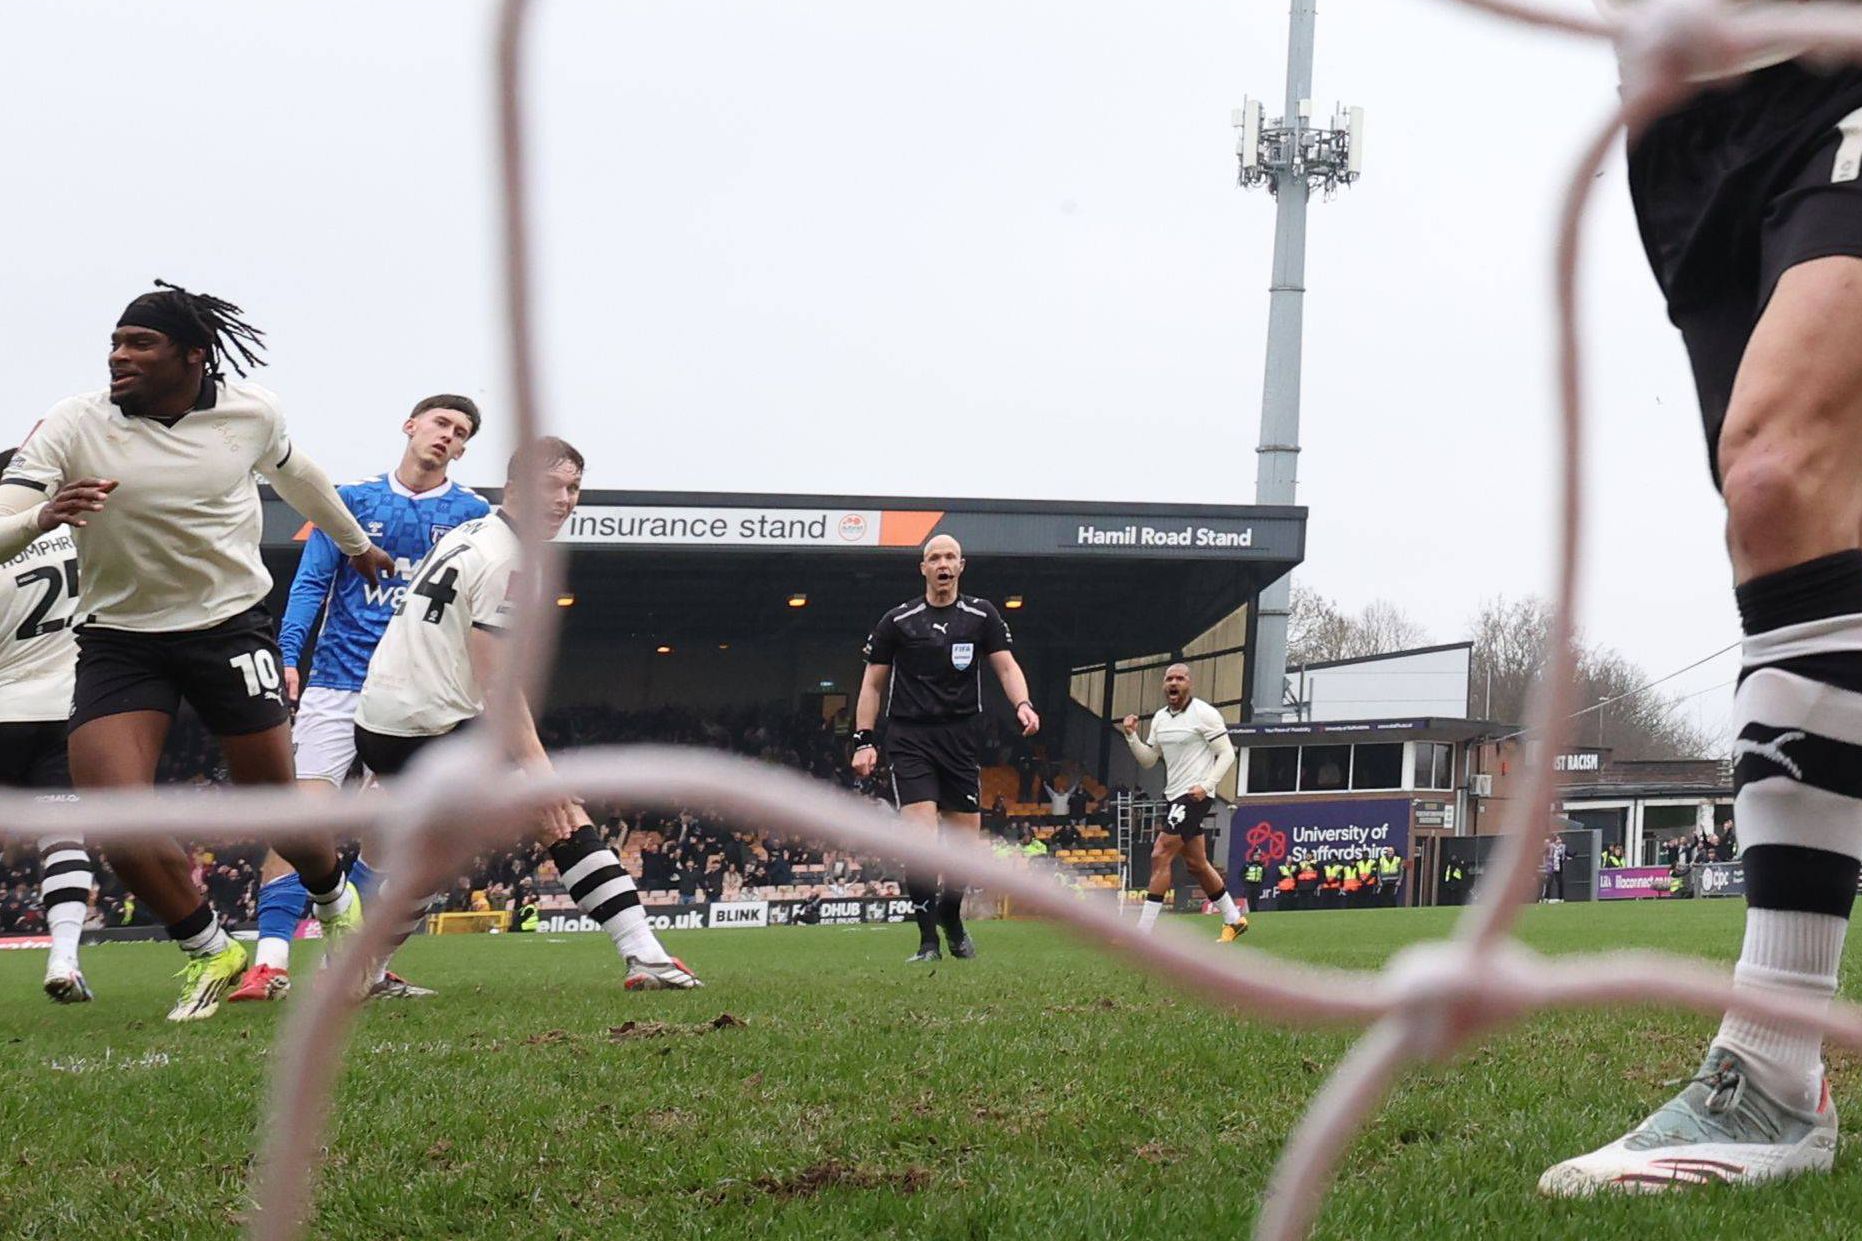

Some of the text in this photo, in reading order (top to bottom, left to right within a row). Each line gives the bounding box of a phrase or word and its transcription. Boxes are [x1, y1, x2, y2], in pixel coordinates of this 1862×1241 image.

[569, 511, 827, 540] insurance stand
[1077, 526, 1252, 547] Hamil Road Stand
[230, 648, 280, 697] 10
[1292, 822, 1389, 844] University of
[716, 908, 760, 922] BLINK
